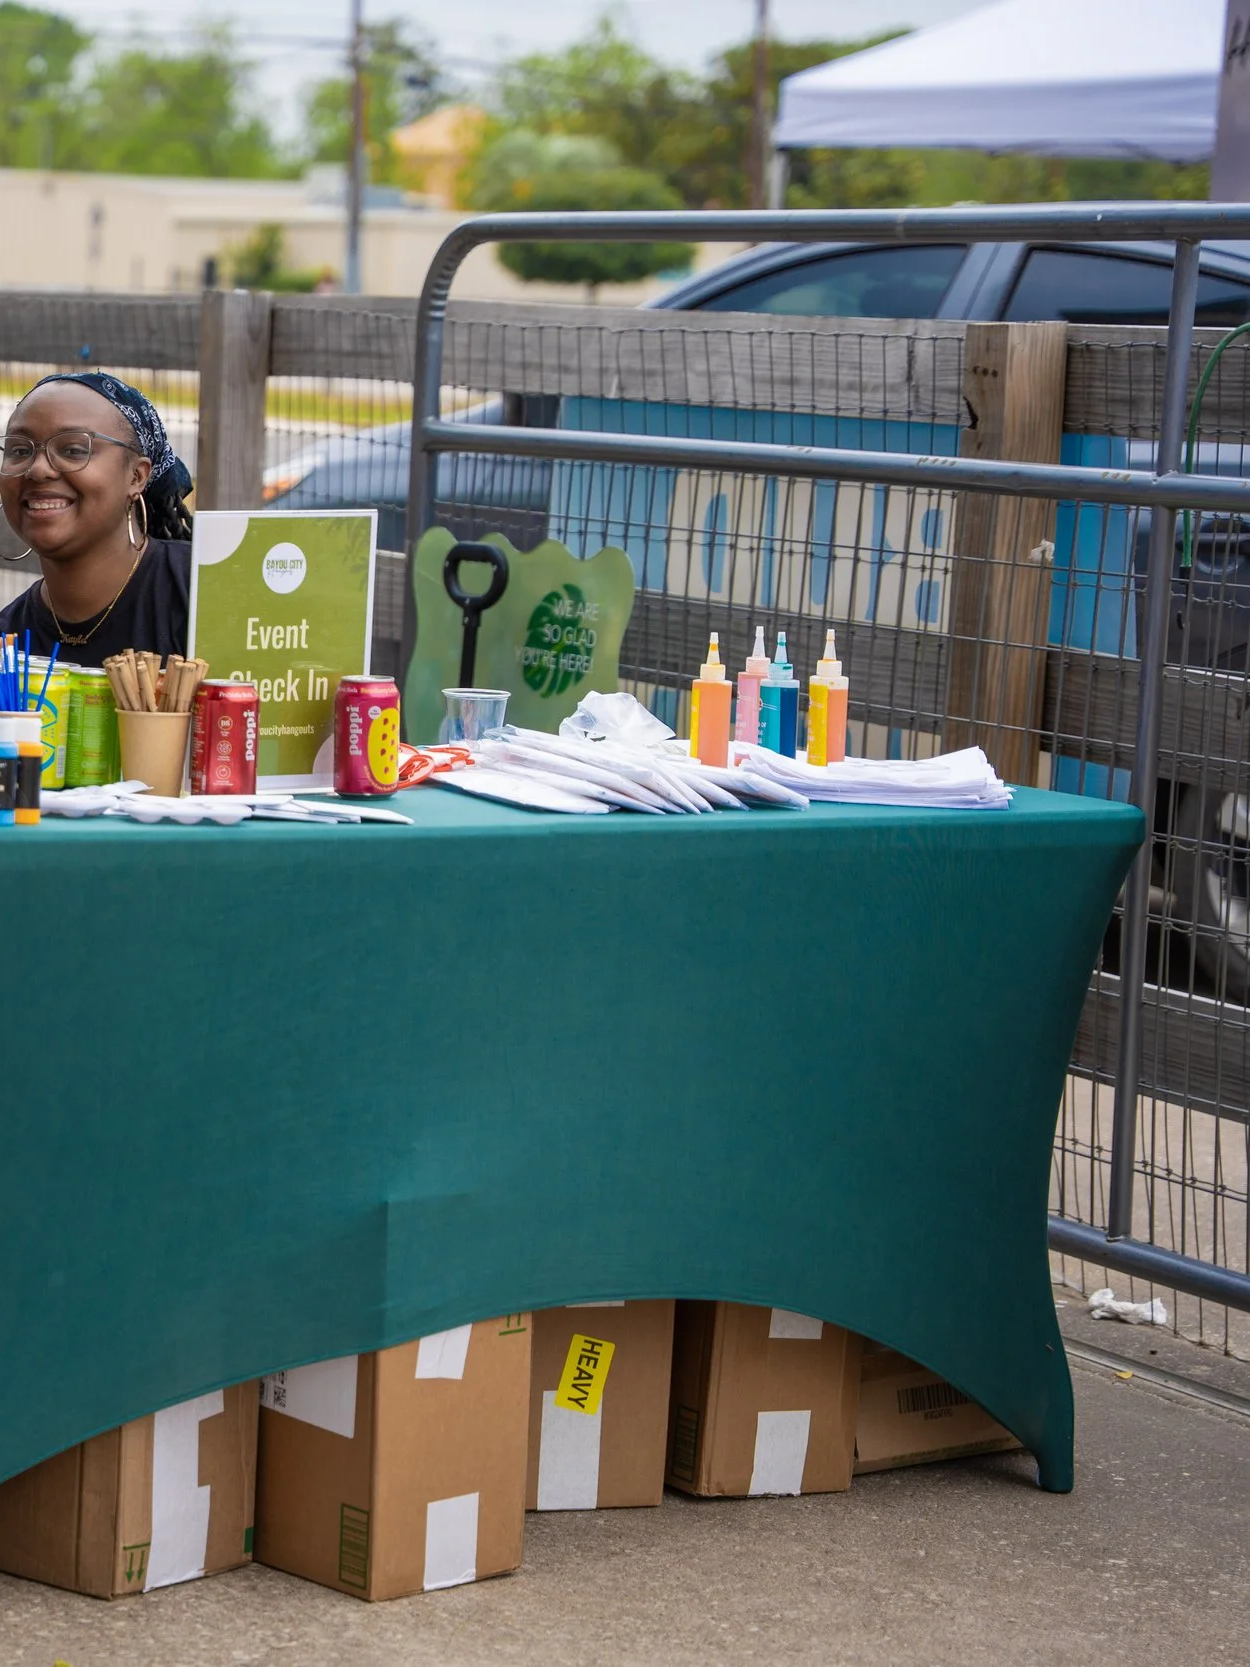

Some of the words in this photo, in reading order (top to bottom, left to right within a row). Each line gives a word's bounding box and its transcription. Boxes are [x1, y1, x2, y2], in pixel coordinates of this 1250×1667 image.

[266, 559, 287, 570] BAYOU
[290, 559, 303, 569] CITY
[553, 600, 574, 618] WE
[576, 602, 599, 620] ARE
[246, 617, 309, 650] Event
[543, 623, 561, 643] SO
[564, 627, 597, 648] GLAD
[515, 644, 557, 669] YOU'RE
[229, 670, 300, 702] eck
[308, 669, 328, 701] In
[244, 710, 257, 761] poppi
[259, 724, 315, 737] oucityhangouts
[346, 705, 363, 755] poppi
[568, 1339, 603, 1409] HEAVY
